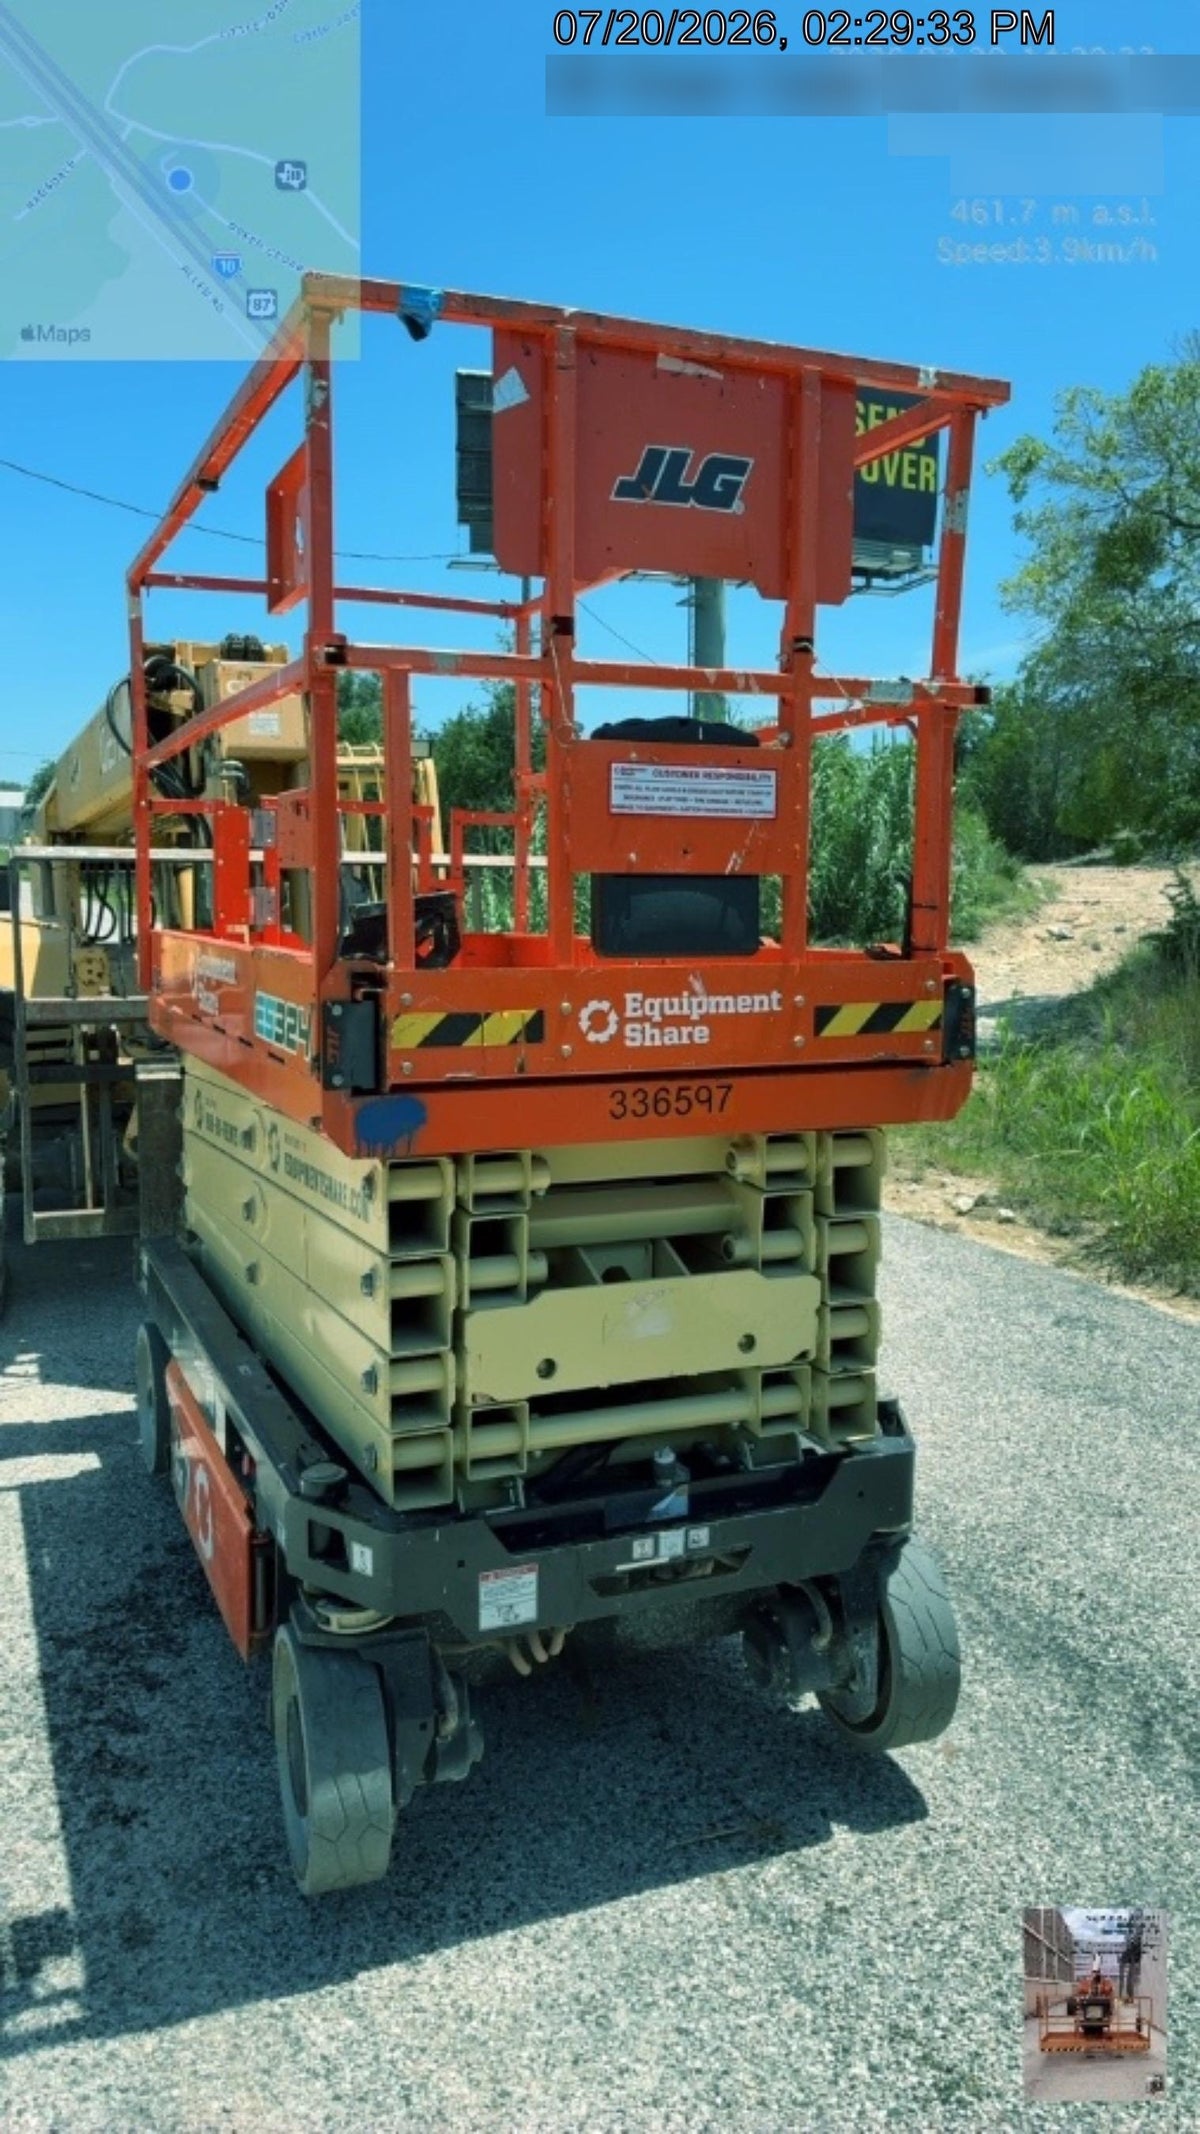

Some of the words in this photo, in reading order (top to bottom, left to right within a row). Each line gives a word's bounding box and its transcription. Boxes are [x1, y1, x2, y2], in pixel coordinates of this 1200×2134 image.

[610, 446, 753, 513] JLG
[651, 769, 699, 779] CUSTOMER
[702, 771, 772, 782] RESPONSIBILITY
[624, 989, 782, 1020] Equipment
[624, 1022, 709, 1047] Share
[609, 1084, 734, 1120] 336597
